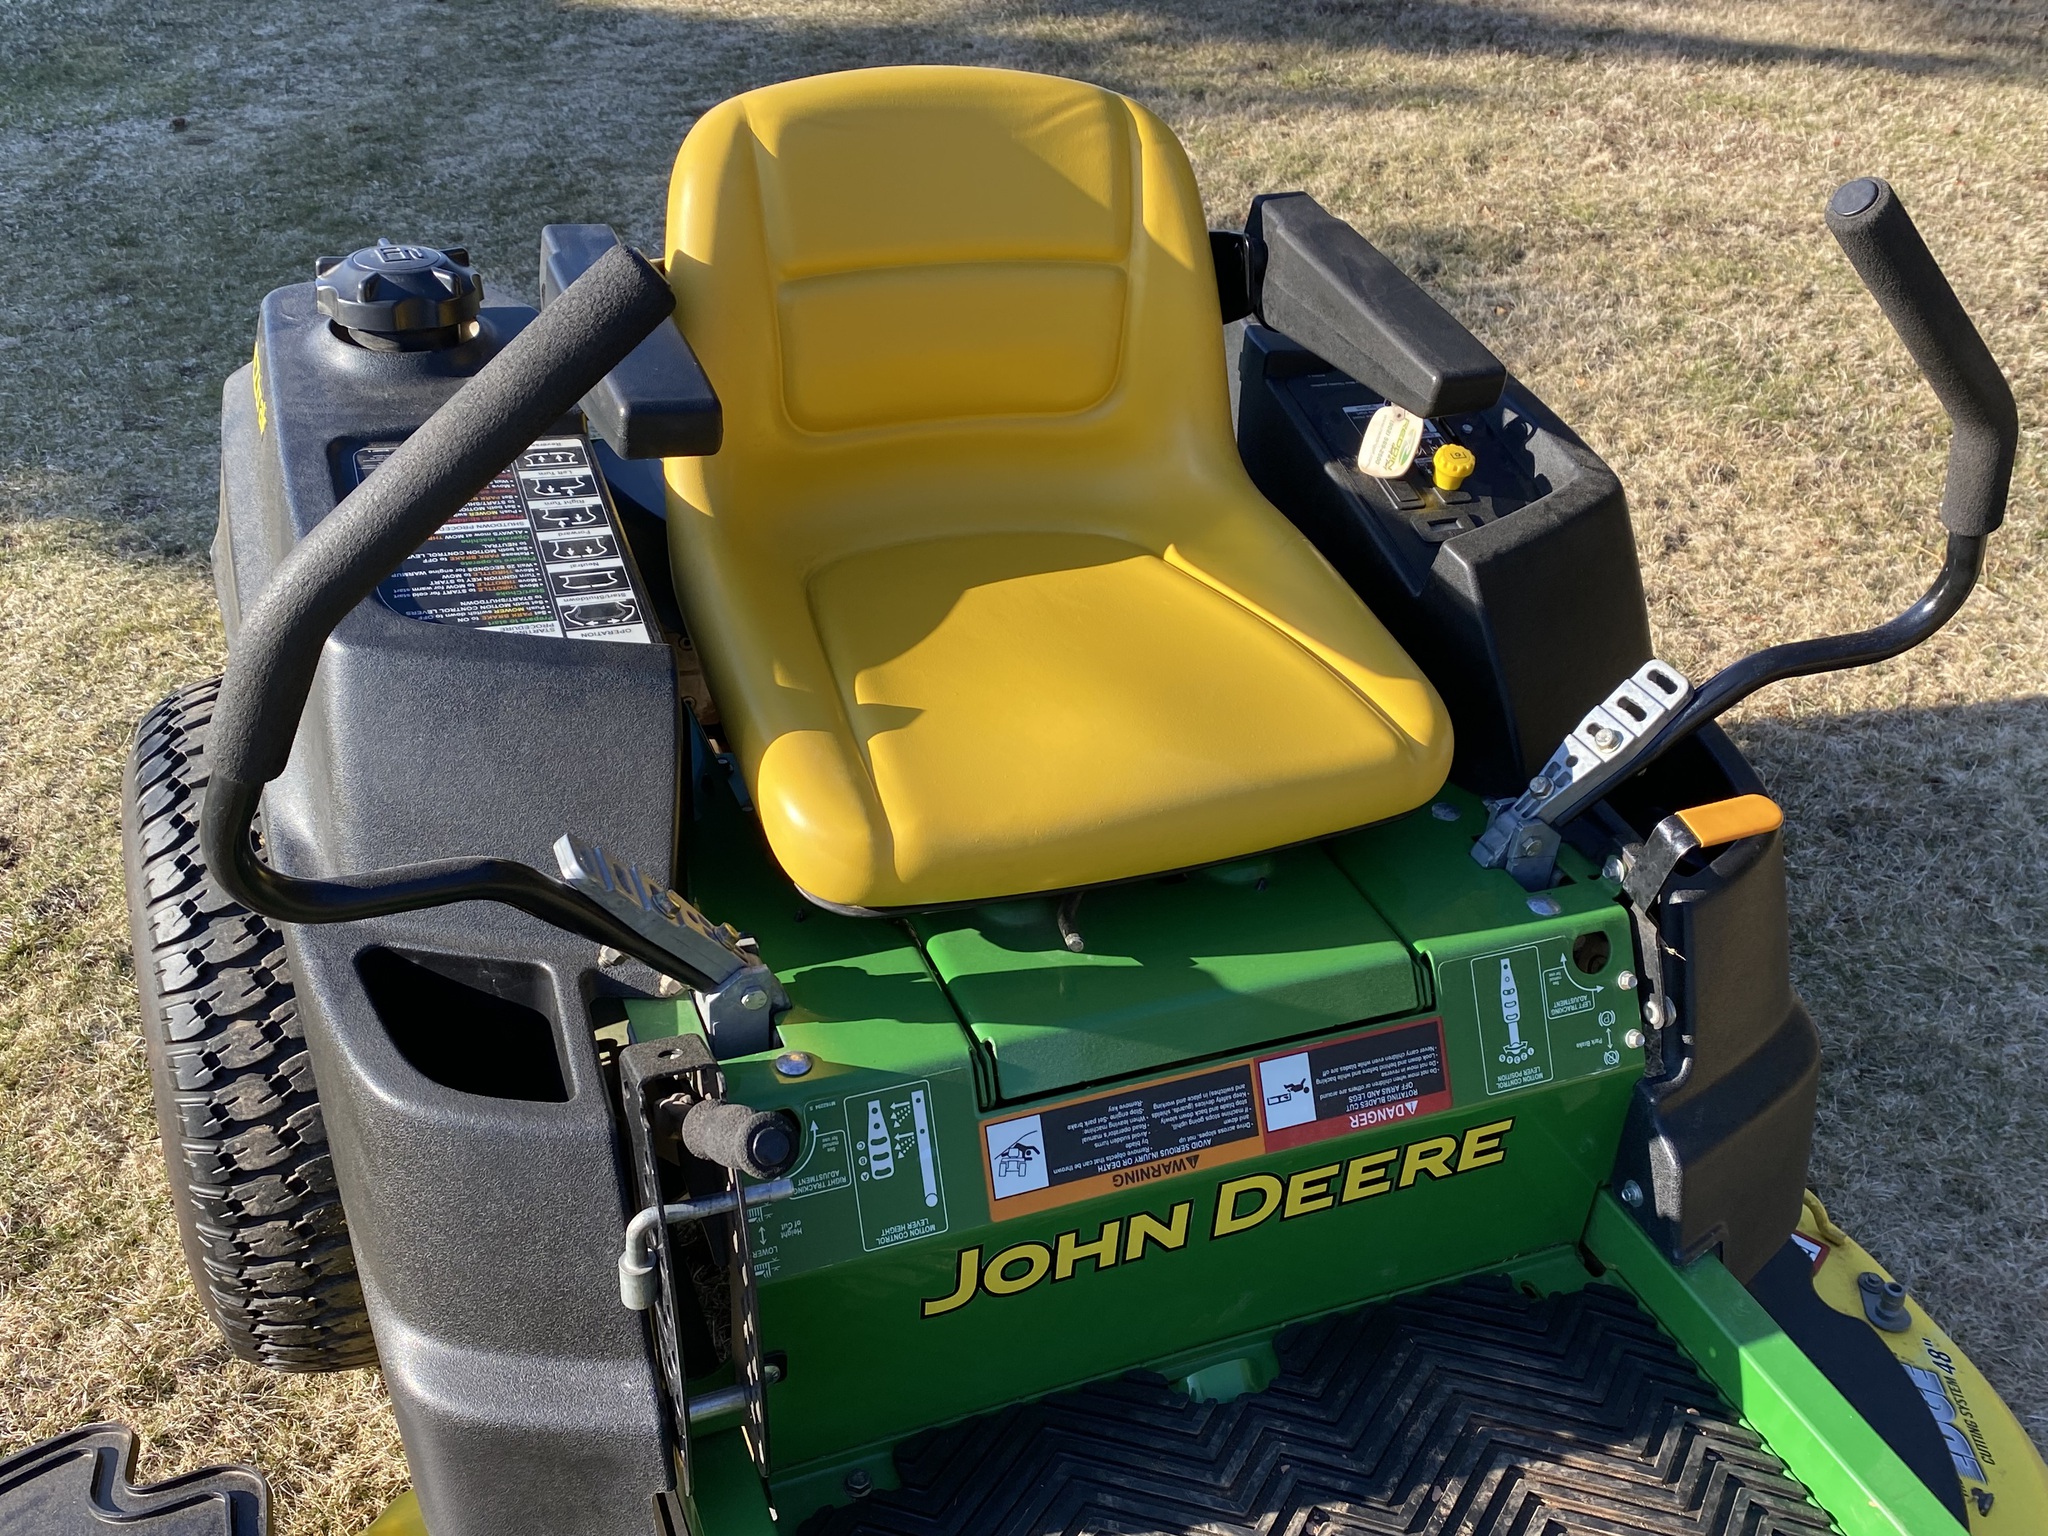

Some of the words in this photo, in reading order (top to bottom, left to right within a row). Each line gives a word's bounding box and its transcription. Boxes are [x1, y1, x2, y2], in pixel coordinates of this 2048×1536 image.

[475, 521, 524, 529] SHUTDOWN
[460, 536, 495, 544] machine
[494, 588, 545, 596] Start/Choke
[562, 592, 626, 602] Start/Shutdown
[459, 595, 533, 605] START/SHUTDOWN
[499, 622, 554, 631] PROCEDURE
[579, 628, 632, 637] OPERATION
[1552, 994, 1587, 1008] ADJUSTMENT
[1578, 1000, 1591, 1009] LEFT
[1550, 1003, 1577, 1015] TRACKING
[1575, 1040, 1590, 1048] Brake
[1590, 1037, 1602, 1045] Park
[1406, 1063, 1418, 1071] mow
[1522, 1066, 1540, 1075] LEVER
[1380, 1068, 1399, 1077] reverse
[1497, 1070, 1522, 1081] POSITION
[1522, 1072, 1543, 1082] MOTION
[1400, 1081, 1413, 1090] OFF
[1495, 1077, 1522, 1089] CONTROL
[1232, 1089, 1246, 1099] Keep
[1366, 1089, 1380, 1098] AND
[1381, 1084, 1399, 1094] ARMS
[1215, 1093, 1231, 1103] safety
[1348, 1092, 1365, 1103] LEGS
[1386, 1088, 1417, 1101] ROTATING
[1118, 1098, 1143, 1110] -Remove
[1194, 1097, 1214, 1108] devices
[1345, 1102, 1358, 1111] CUT
[1359, 1095, 1385, 1108] BLADES
[1107, 1104, 1117, 1113] key
[1129, 1106, 1143, 1116] -Stop
[1171, 1102, 1193, 1114] (guards,
[1220, 1106, 1243, 1118] machine
[1244, 1104, 1248, 1112] If
[1109, 1110, 1128, 1120] engine
[1129, 1113, 1145, 1124] When
[1151, 1108, 1170, 1119] shields
[1204, 1111, 1220, 1122] stops
[1239, 1113, 1249, 1121] and
[1349, 1103, 1404, 1128] DANGER
[1083, 1118, 1096, 1127] park
[1097, 1115, 1108, 1123] -Set
[1108, 1118, 1128, 1129] leaving
[1188, 1115, 1204, 1126] going
[1223, 1116, 1238, 1125] down
[1066, 1121, 1083, 1131] brake
[1082, 1123, 1107, 1135] machine:
[1131, 1121, 1146, 1131] Read
[1171, 1119, 1187, 1130] uphill,
[1217, 1124, 1235, 1135] across
[1236, 1120, 1250, 1130] Drive
[1103, 1125, 1130, 1138] operator's
[1131, 1130, 1147, 1139] Avoid
[1197, 1129, 1216, 1139] slopes,
[1081, 1132, 1102, 1143] manual
[1109, 1134, 1130, 1144] sudden
[1141, 1137, 1148, 1145] by
[1178, 1136, 1186, 1144] up
[1186, 1133, 1196, 1142] not
[1094, 1139, 1108, 1148] turns
[1124, 1139, 1140, 1149] blade
[1190, 1137, 1211, 1149] AVOID
[1127, 1145, 1149, 1156] Remove
[1159, 1143, 1189, 1156] SERIOUS
[1093, 1156, 1104, 1165] that
[1105, 1150, 1126, 1162] objects
[1134, 1150, 1158, 1163] INJURY
[1073, 1161, 1081, 1169] be
[1082, 1158, 1092, 1167] can
[1097, 1160, 1120, 1172] DEATH
[1121, 1157, 1132, 1166] OR
[1052, 1163, 1073, 1175] thrown
[1111, 1157, 1186, 1187] WARNING
[796, 1169, 839, 1185] ADJUSTMENT
[826, 1175, 846, 1186] RIGHT
[793, 1219, 801, 1227] of
[906, 1217, 928, 1229] LEVER
[920, 1199, 1195, 1320] JOHN
[1210, 1118, 1516, 1241] DEERE
[780, 1221, 793, 1230] Cut
[880, 1223, 905, 1236] HEIGHT
[909, 1223, 935, 1236] MOTION
[780, 1225, 802, 1239] Height
[875, 1230, 908, 1245] CONTROL
[751, 1245, 777, 1258] LOWER
[1922, 1337, 1956, 1376] 48"
[1943, 1375, 1974, 1420] SYSTEM
[1964, 1418, 1996, 1466] CUTTING
